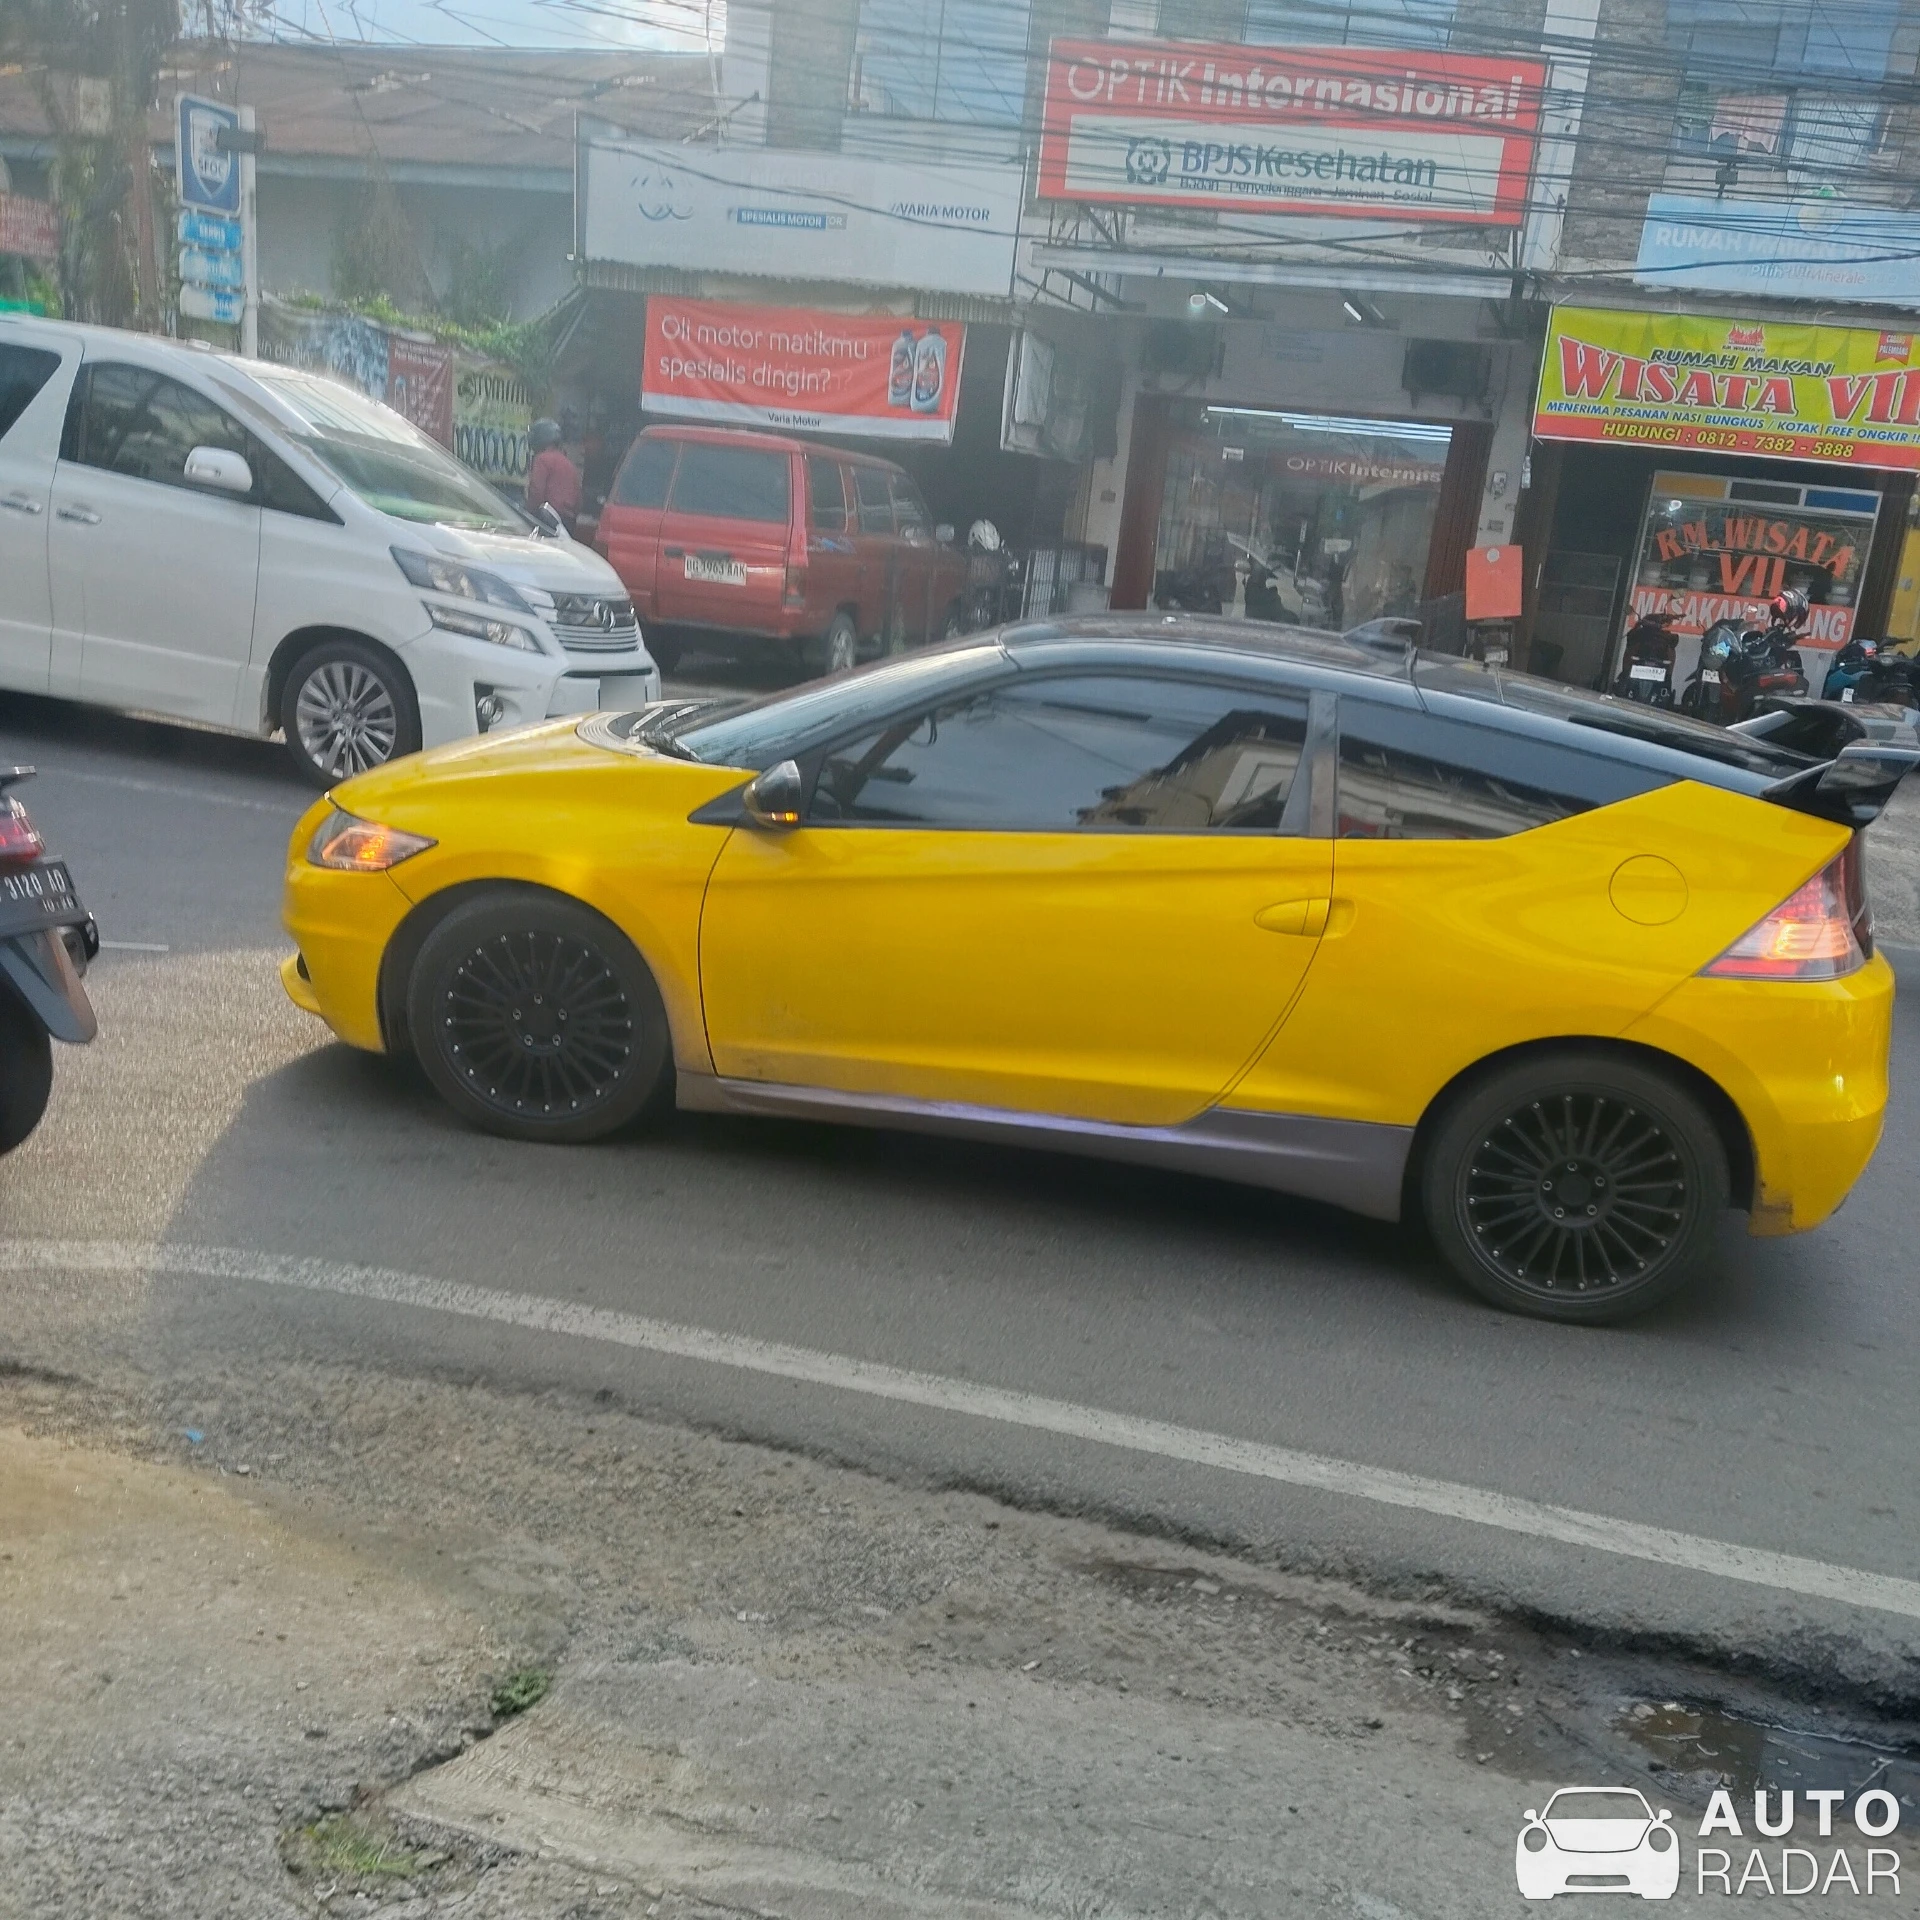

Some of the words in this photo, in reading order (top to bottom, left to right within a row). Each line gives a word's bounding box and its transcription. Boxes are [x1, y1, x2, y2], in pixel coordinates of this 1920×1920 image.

[1068, 57, 1196, 102] OPTIK
[1200, 63, 1523, 120] Internasional
[787, 212, 823, 228] MOTOR
[942, 205, 991, 222] MOTOR
[661, 314, 691, 341] Oli
[697, 323, 764, 350] motor
[769, 329, 868, 360] matikmu
[660, 355, 747, 384] spesialis
[752, 364, 832, 397] dingin?
[1558, 334, 1798, 416] WISATA
[1650, 348, 1739, 370] RUMAH
[1743, 355, 1835, 377] MAKAN
[768, 412, 791, 426] Varia
[794, 416, 822, 428] Motor
[1546, 402, 1610, 416] MENERIMA
[1612, 406, 1670, 420] PESANAN
[1672, 411, 1701, 423] NASI
[1704, 414, 1765, 429] BUNGKUS
[1777, 421, 1819, 434] KOTAK
[1825, 425, 1855, 437] FREE
[1857, 428, 1909, 443] ONGKIR
[1602, 422, 1683, 442] HUBUNGI
[1696, 430, 1738, 447] 0812
[1754, 435, 1796, 452] 7382
[1811, 441, 1855, 458] 5888
[1724, 517, 1856, 578] WISATA
[1719, 552, 1786, 598] VII
